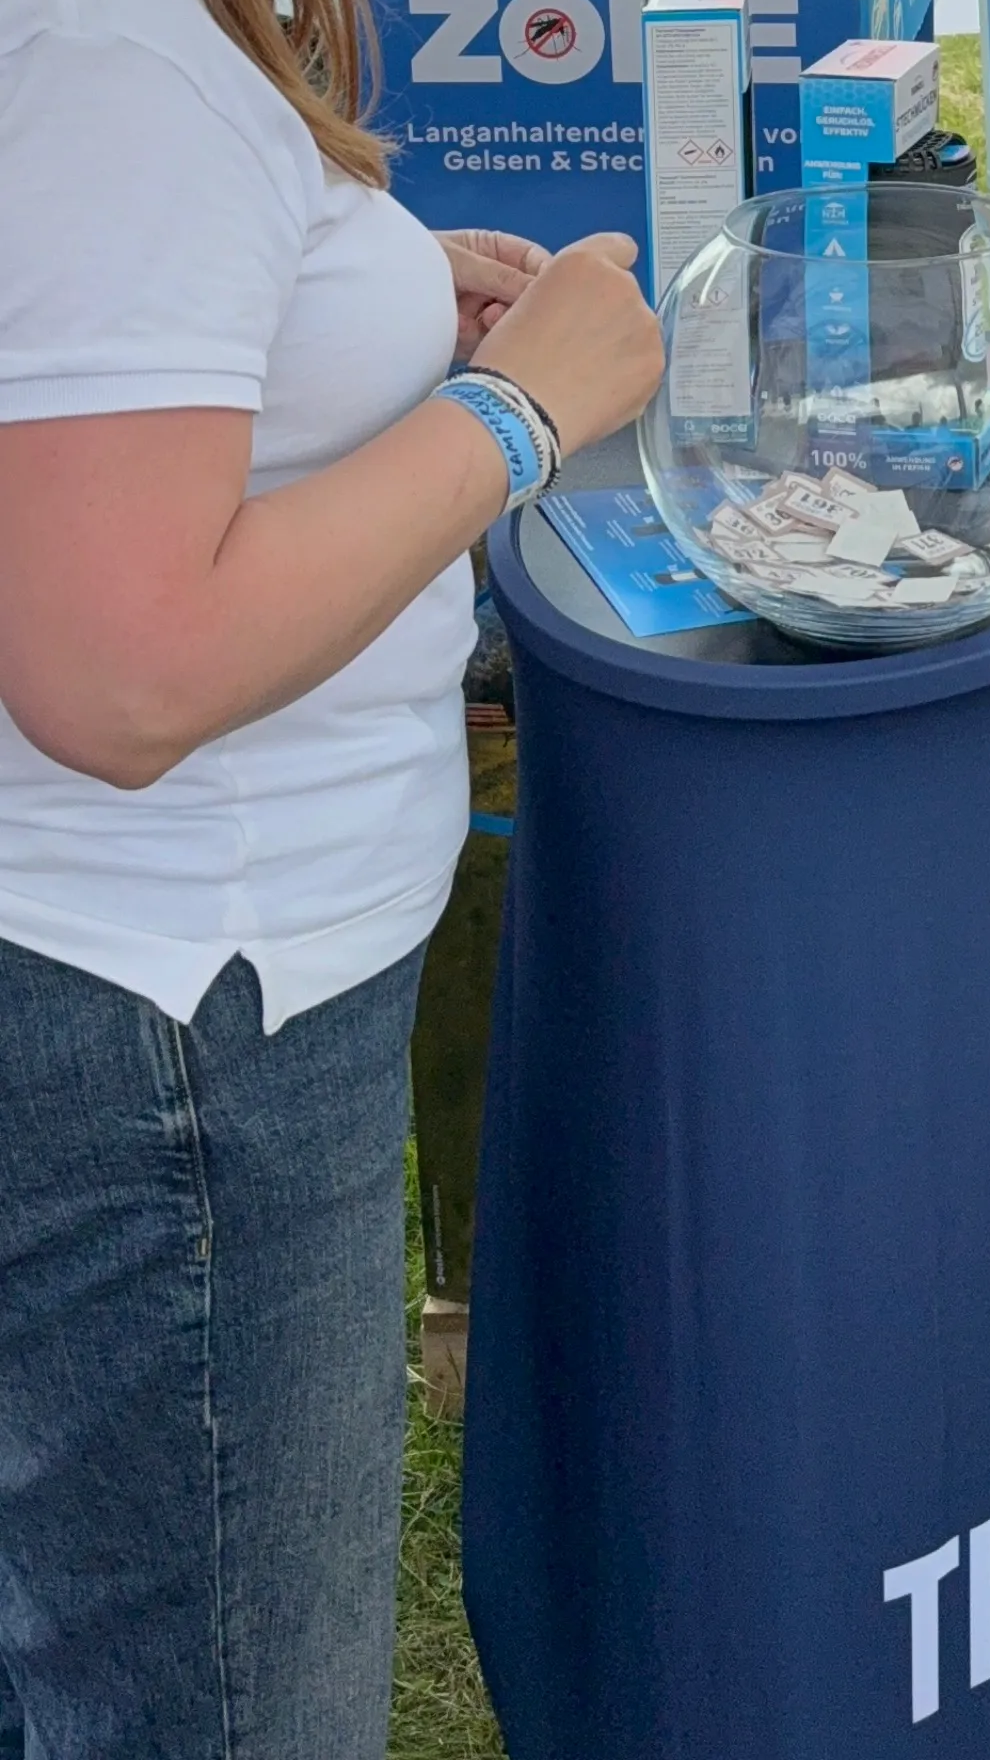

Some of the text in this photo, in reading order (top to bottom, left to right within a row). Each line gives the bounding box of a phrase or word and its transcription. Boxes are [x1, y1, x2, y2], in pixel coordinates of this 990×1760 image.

[406, 122, 801, 147] Langanhaltender vo
[443, 150, 541, 172] Gelsen
[550, 151, 571, 172] &
[451, 388, 523, 477] CAMPERVAN
[811, 449, 867, 470] 100%
